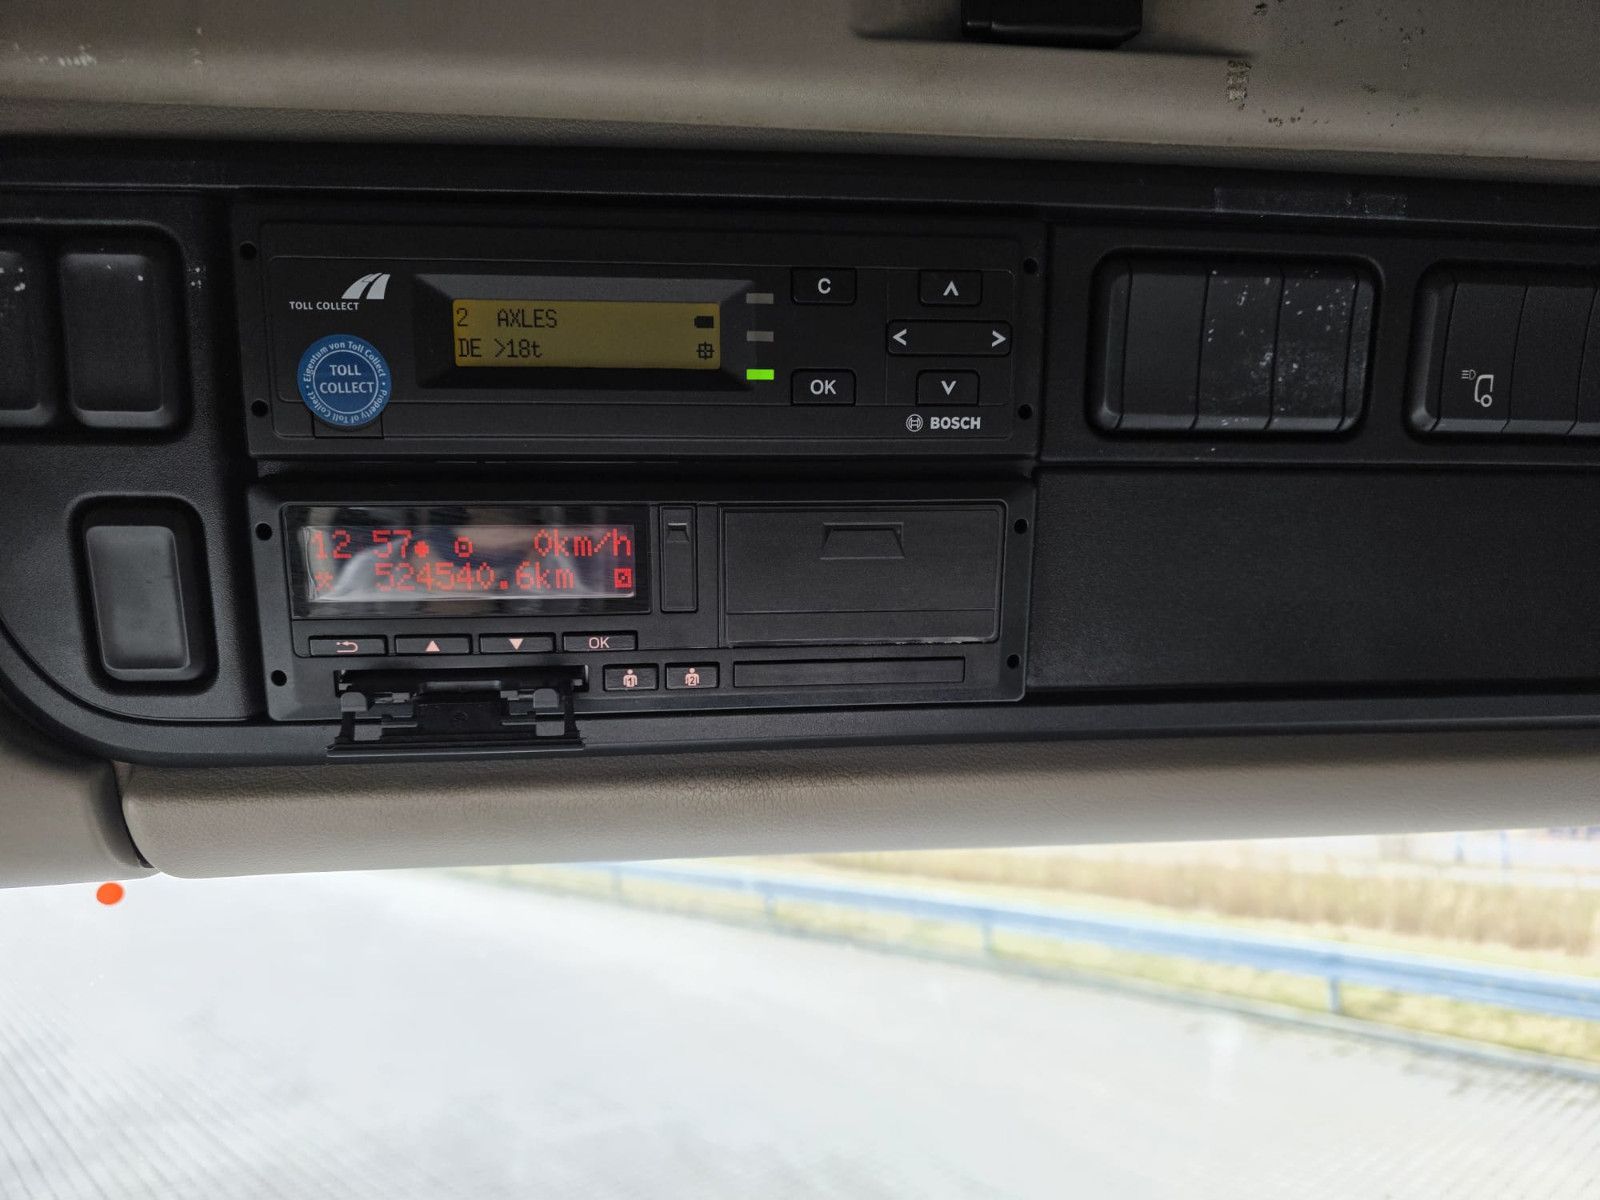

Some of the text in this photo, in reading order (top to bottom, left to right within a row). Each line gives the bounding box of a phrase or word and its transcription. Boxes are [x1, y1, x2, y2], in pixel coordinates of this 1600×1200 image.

[817, 278, 832, 295] C
[289, 301, 359, 311] TOLL COLLECT
[456, 308, 558, 328] 2 AXLES
[458, 338, 482, 358] DE
[303, 341, 386, 382] Eigentum von Toll Collect
[329, 364, 362, 376] TOLL
[319, 382, 375, 394] COLLECT
[810, 379, 837, 395] OK
[306, 389, 388, 424] Property of Toll Collect
[930, 416, 982, 430] BOSCH
[311, 528, 633, 560] 12 57 0km/h
[588, 636, 610, 649] OK
